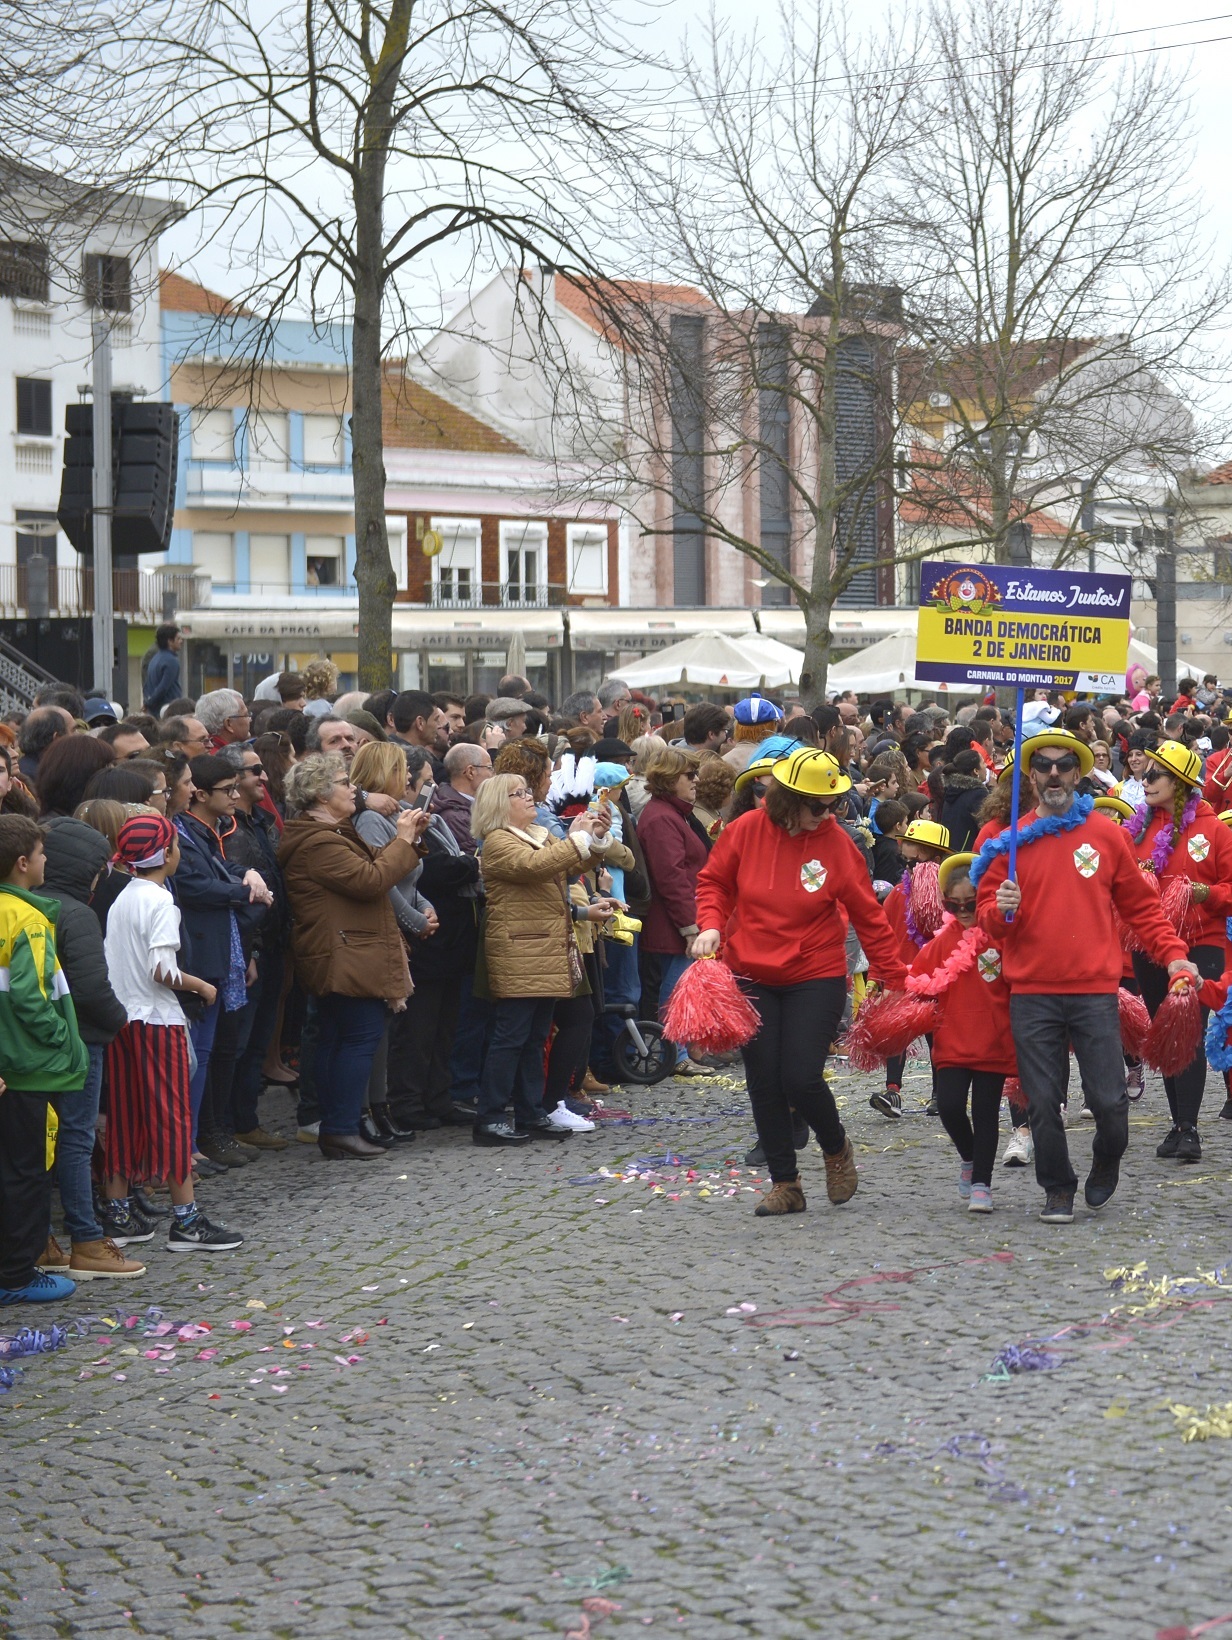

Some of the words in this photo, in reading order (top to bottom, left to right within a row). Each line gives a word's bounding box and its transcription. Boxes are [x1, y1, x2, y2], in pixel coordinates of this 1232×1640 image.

[1004, 581, 1067, 606] Estamos
[1065, 584, 1125, 609] Juntos!
[224, 623, 255, 635] CAFÉ
[259, 626, 275, 635] DA
[281, 626, 321, 636] PRAÇA
[944, 617, 993, 637] BANDA
[997, 620, 1102, 645] DEMOCRÁTICA
[422, 634, 452, 645] CAFÉ
[457, 636, 472, 645] DA
[616, 638, 645, 647] CAFÉ
[651, 639, 667, 647] DA
[972, 639, 982, 657] 2
[986, 640, 1005, 659] DE
[1008, 642, 1071, 663] JANEIRO
[966, 670, 1005, 682] CARNAVAL
[1005, 672, 1017, 682] DO
[1017, 673, 1053, 684] MONTIJO
[1053, 674, 1074, 685] 2017
[1100, 675, 1116, 686] CA
